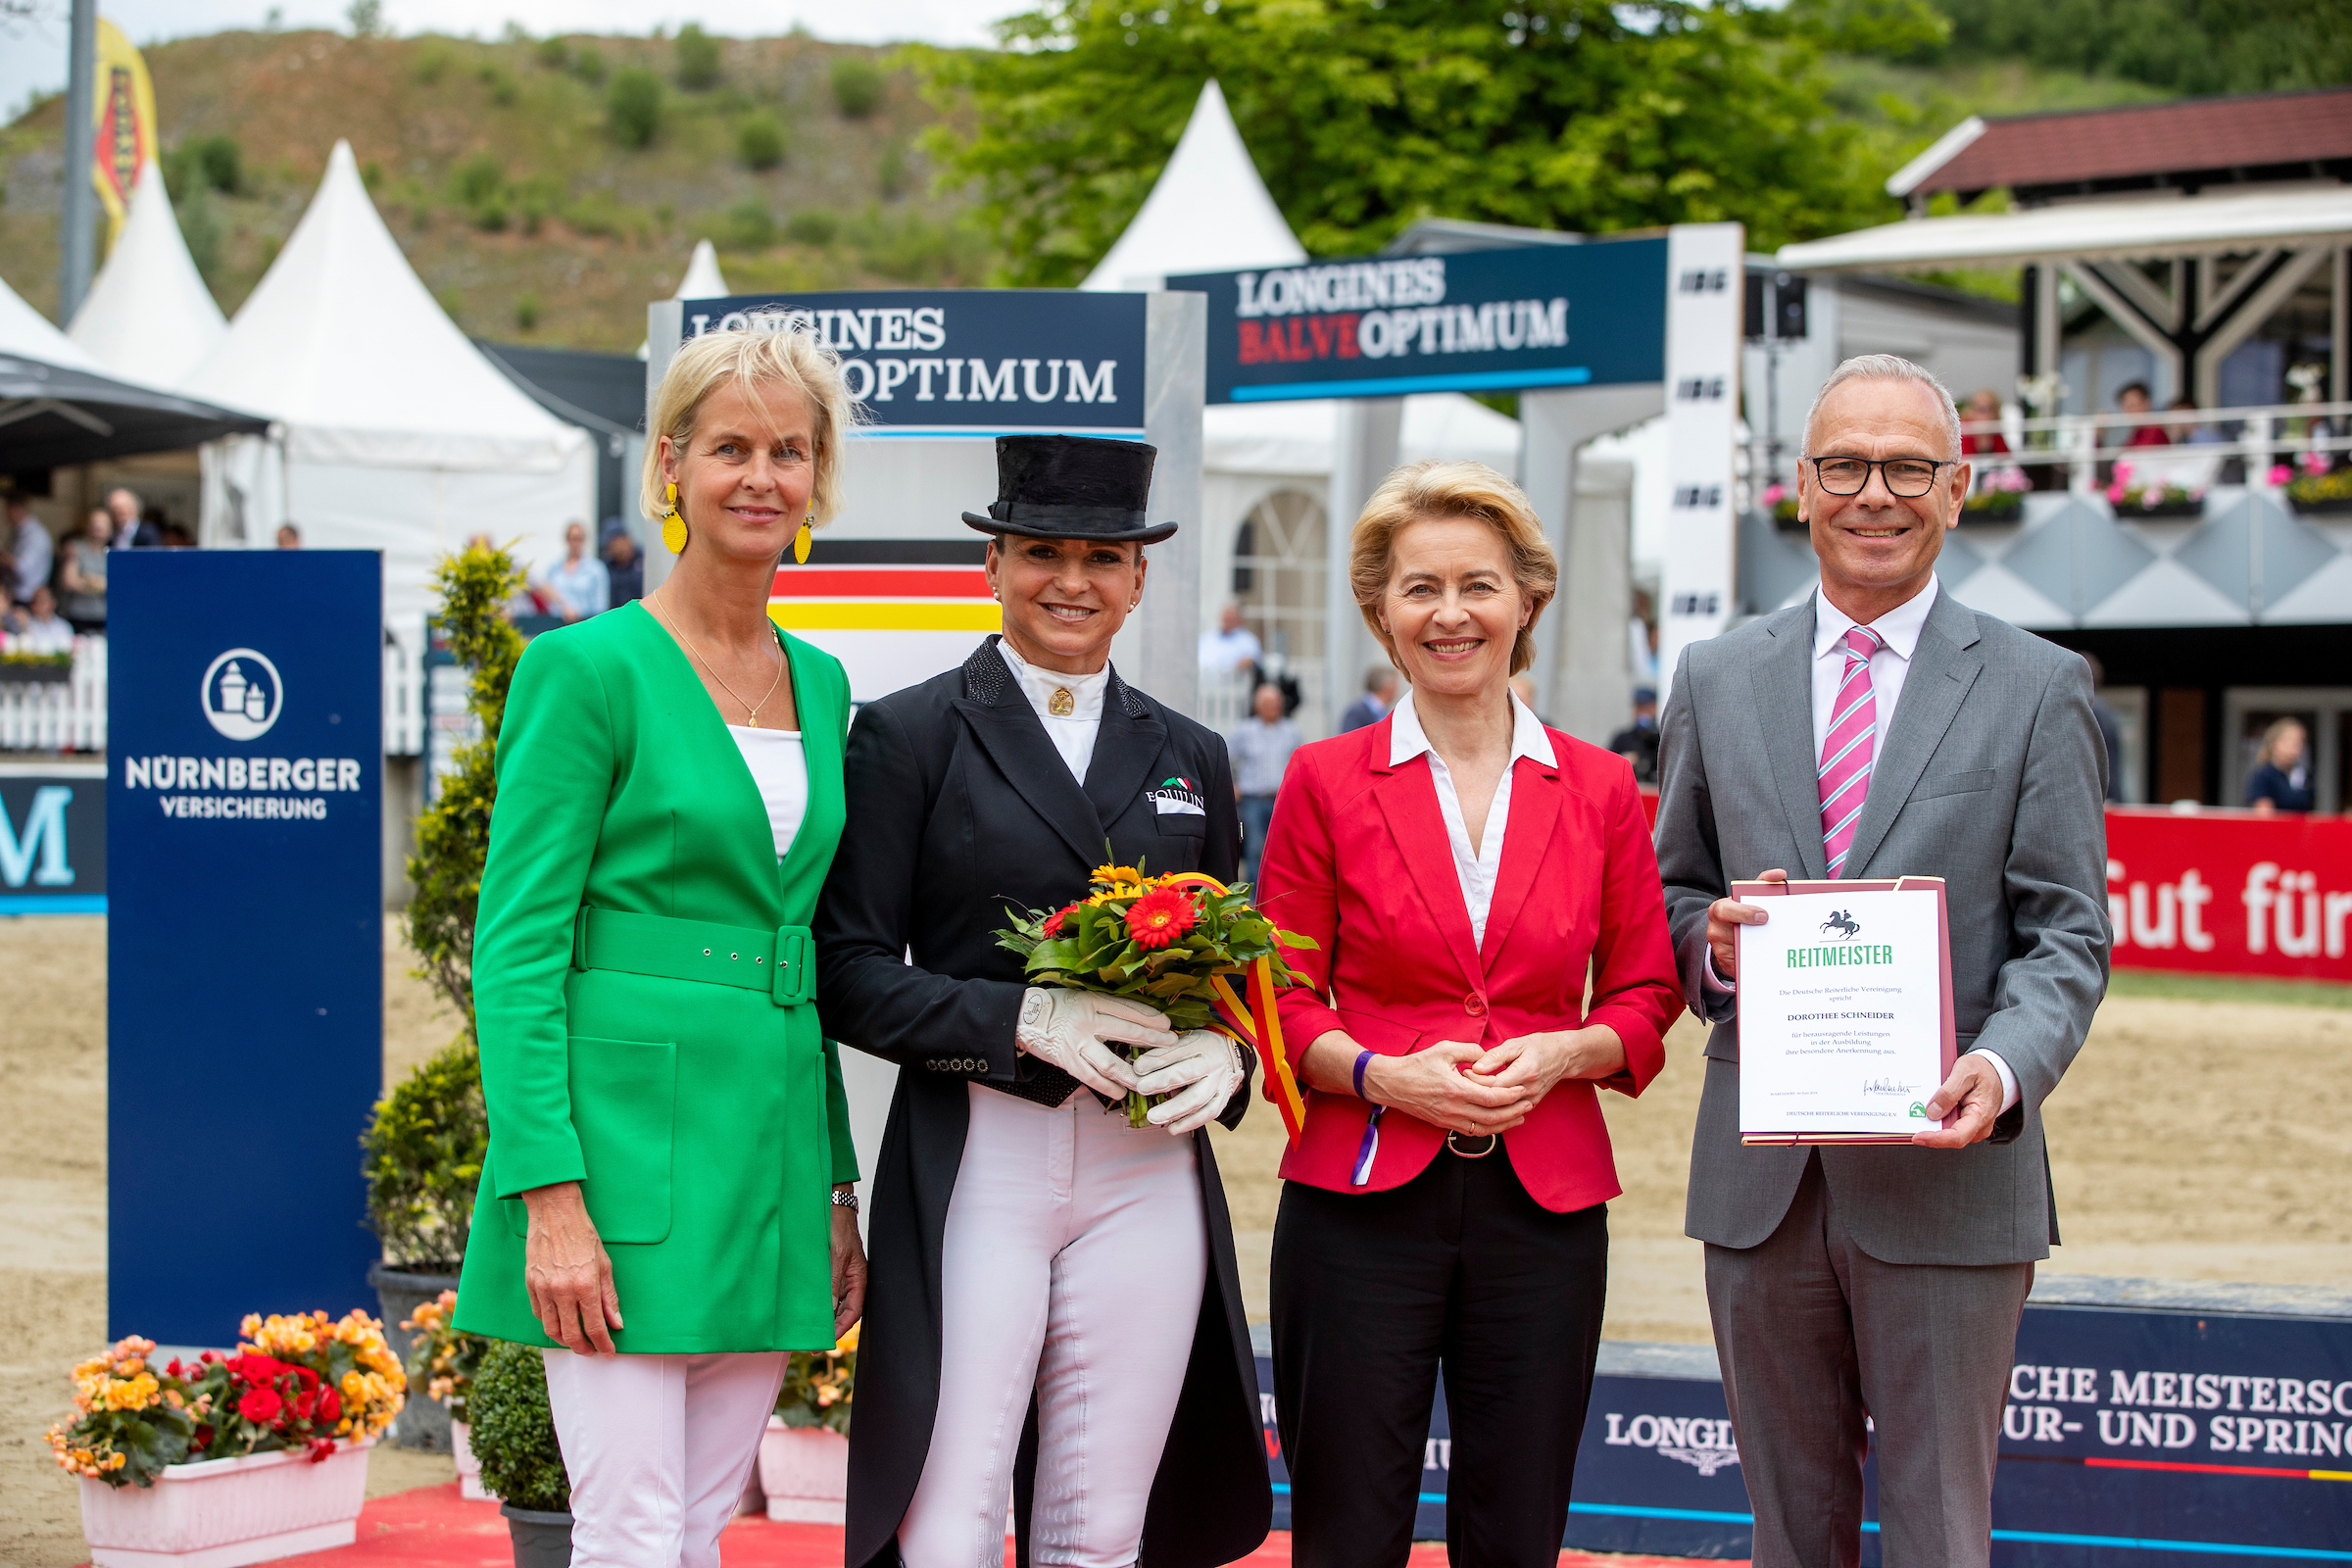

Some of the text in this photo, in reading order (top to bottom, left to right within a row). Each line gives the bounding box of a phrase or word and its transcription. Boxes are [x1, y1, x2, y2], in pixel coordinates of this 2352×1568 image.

[1236, 256, 1446, 318] LONGINES
[691, 307, 946, 352] LGINES
[125, 755, 362, 792] NÜRNBERGER
[159, 796, 327, 820] VERSICHERUNG
[1787, 945, 1892, 968] REITMEISTER
[1788, 1011, 1894, 1021] DOROTHEE SCHNEIDER
[1836, 1047, 1883, 1055] Anerkennung
[1605, 1413, 1738, 1451] LONGI
[1998, 1404, 2352, 1457] UR- UND SPRIN
